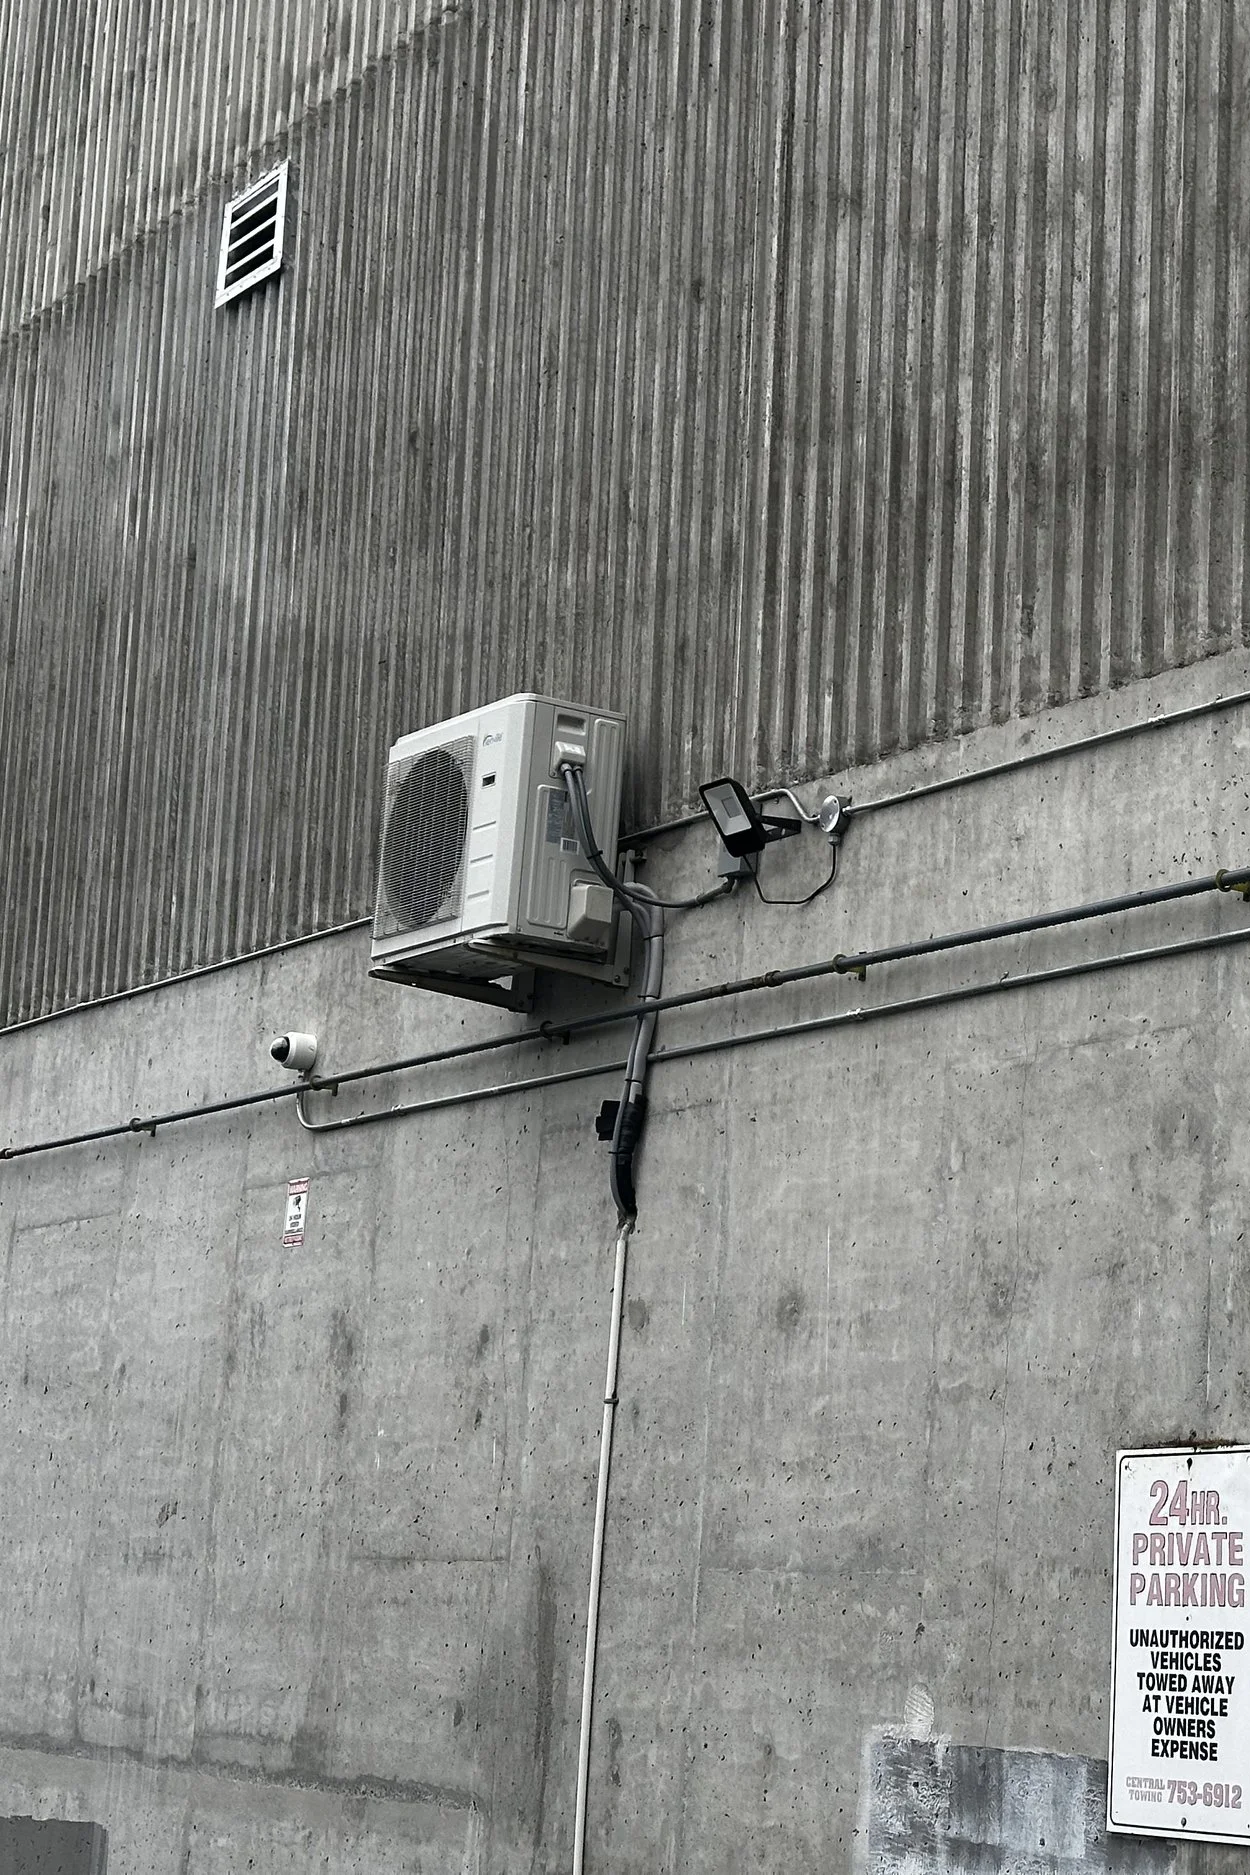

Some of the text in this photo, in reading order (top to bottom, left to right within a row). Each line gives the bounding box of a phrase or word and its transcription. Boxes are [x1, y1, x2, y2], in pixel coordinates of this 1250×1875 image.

[1132, 1532, 1243, 1566] PRIVATE
[1129, 1572, 1245, 1607] PARKING
[1129, 1628, 1245, 1650] UNAUTHORIZED
[1151, 1651, 1222, 1672] VEHICLES
[1137, 1672, 1236, 1695] TOWED AWAY
[1142, 1694, 1229, 1717] AT VEHICLE
[1153, 1716, 1216, 1739] OWNERS
[1151, 1738, 1218, 1761] EXPENSE
[1126, 1776, 1165, 1790] CENTRAL
[1167, 1779, 1242, 1809] 753-6912
[1128, 1789, 1162, 1803] TOWING
